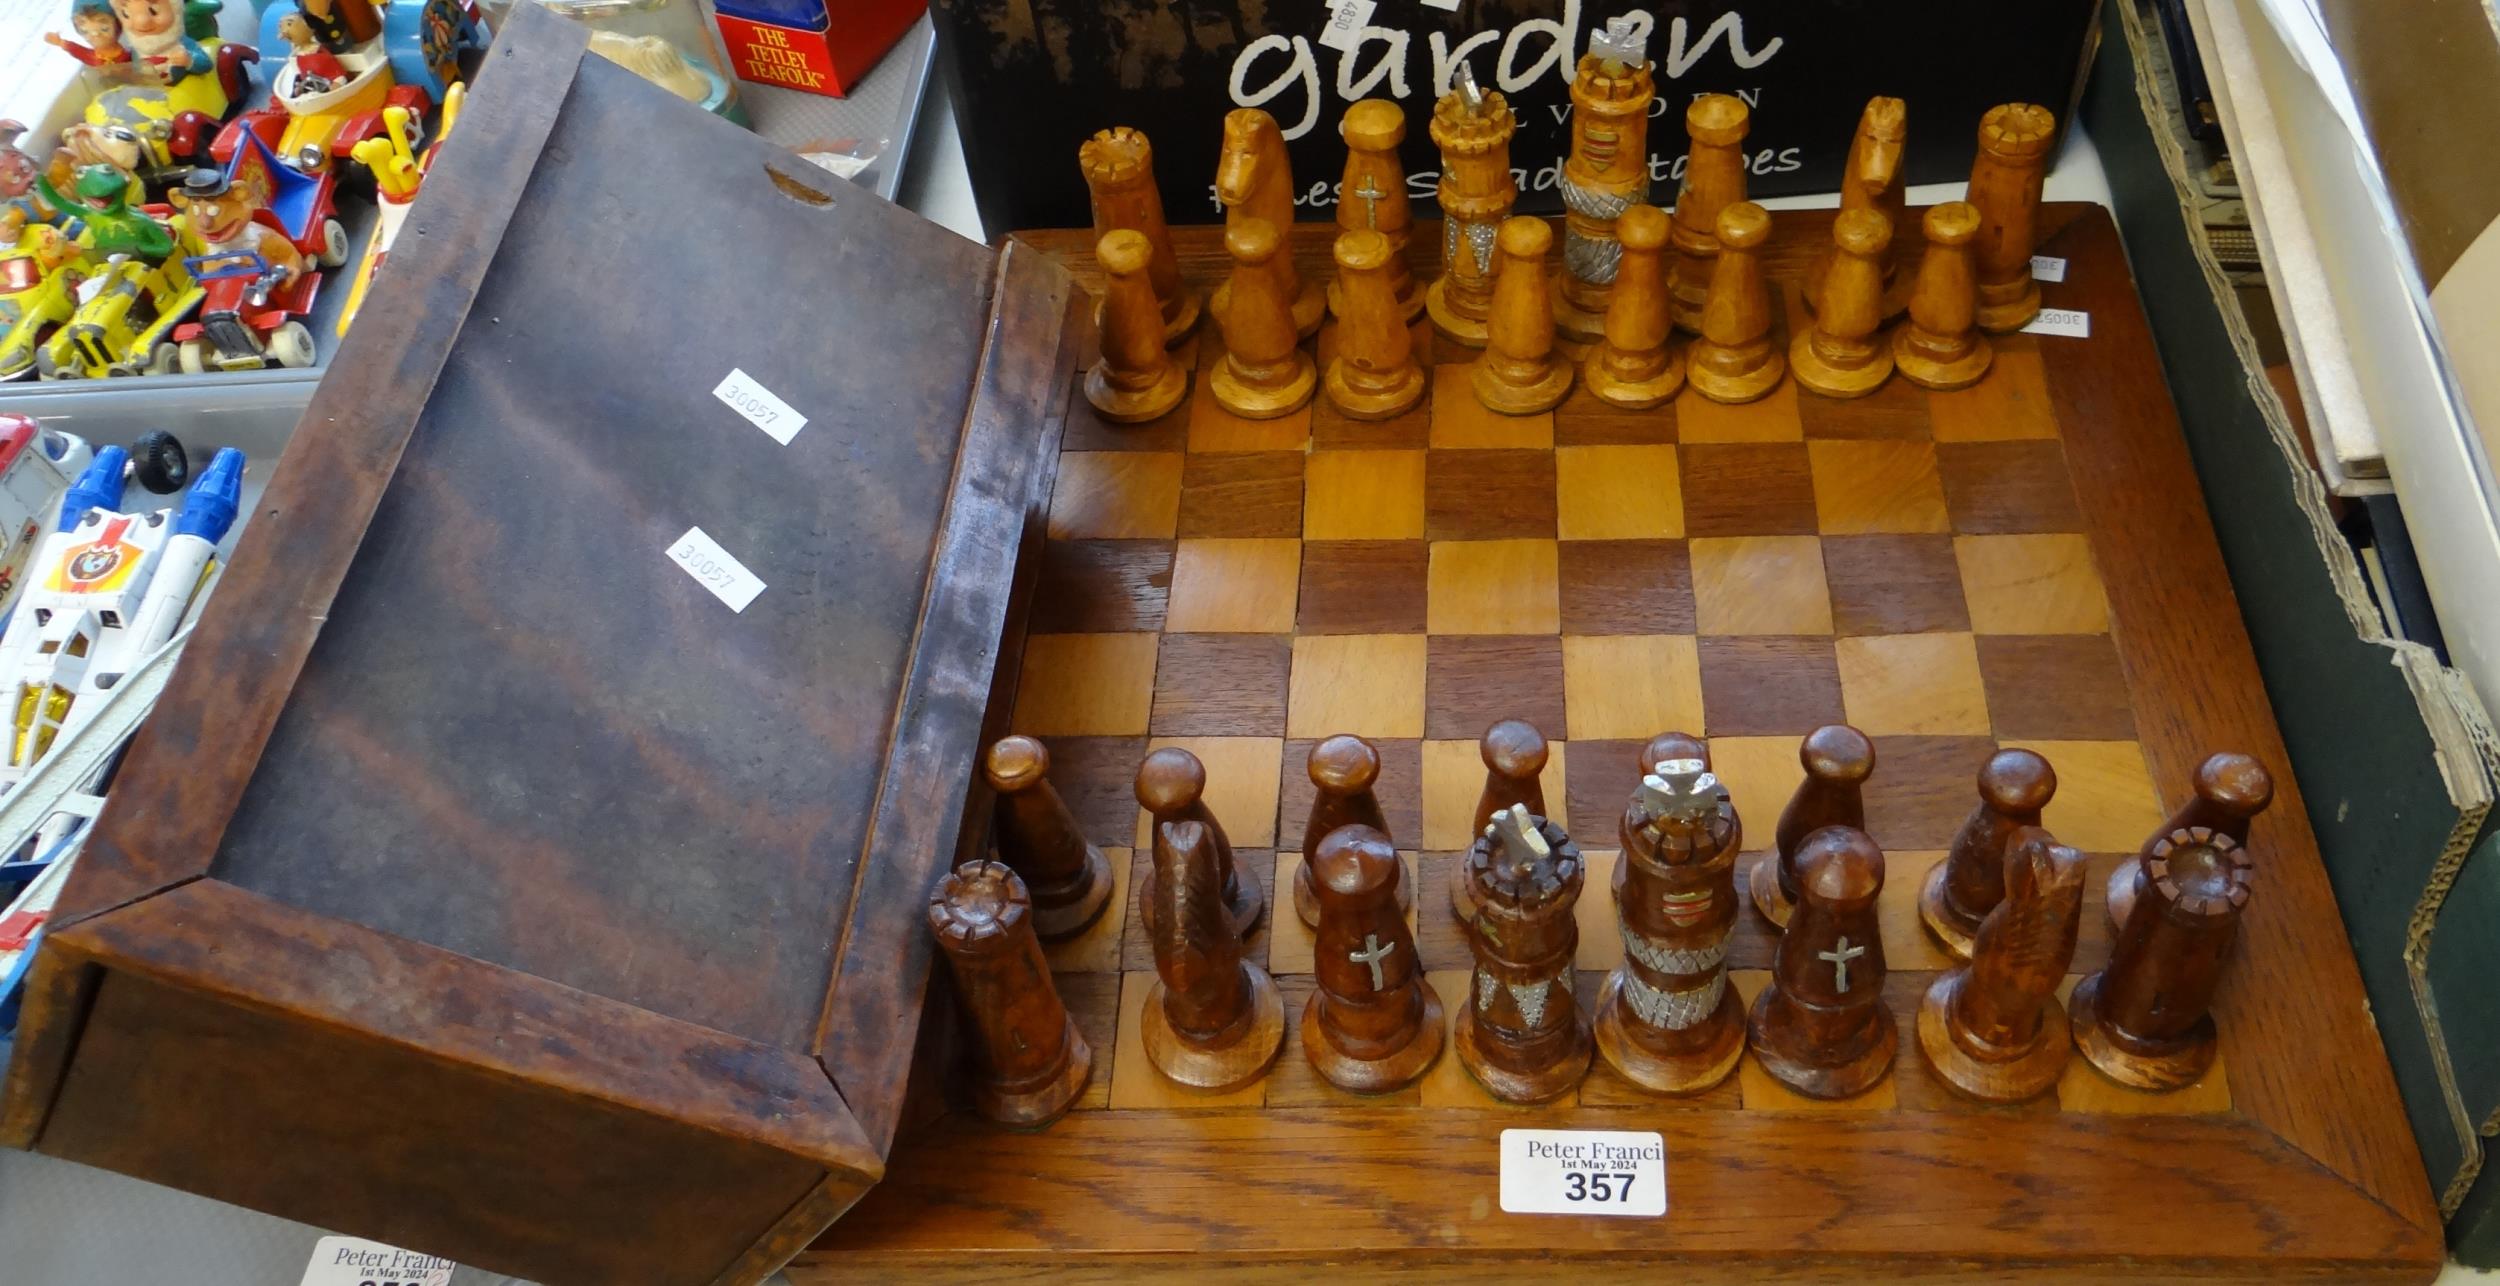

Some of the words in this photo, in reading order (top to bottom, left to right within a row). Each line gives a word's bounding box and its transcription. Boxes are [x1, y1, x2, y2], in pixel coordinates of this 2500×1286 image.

[753, 26, 790, 48] THE
[747, 43, 809, 70] TETLEY
[724, 385, 780, 425] 30057
[678, 544, 737, 589] 30057
[1528, 1141, 1585, 1159] Peter
[1592, 1142, 1661, 1161] Franci
[1561, 1160, 1577, 1169] 1st
[1580, 1160, 1607, 1171] May
[1610, 1160, 1638, 1170] 2024
[1565, 1172, 1636, 1202] 357
[334, 1247, 388, 1267] Peter
[360, 1267, 374, 1277] 1st
[376, 1268, 401, 1280] May
[403, 1269, 429, 1279] 2024
